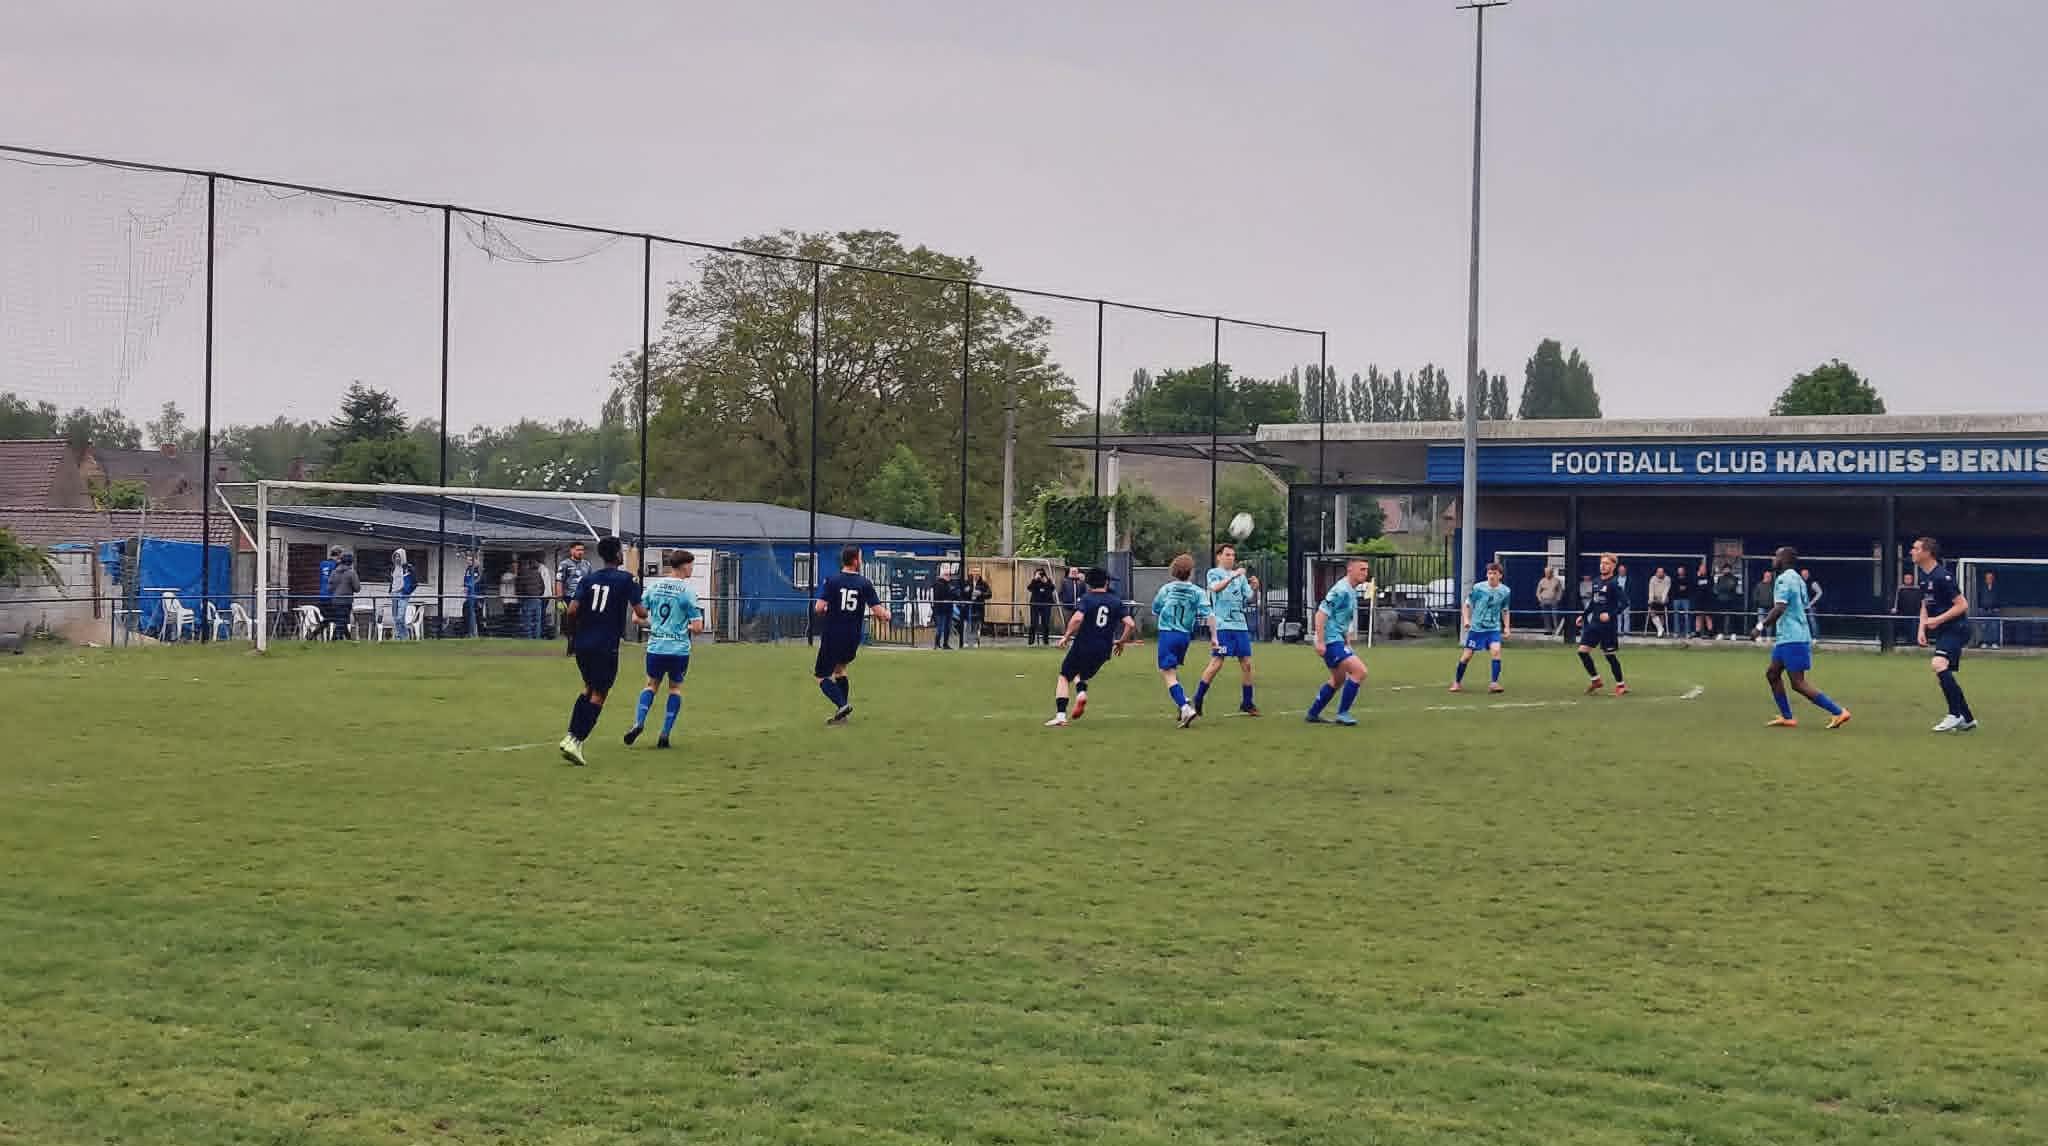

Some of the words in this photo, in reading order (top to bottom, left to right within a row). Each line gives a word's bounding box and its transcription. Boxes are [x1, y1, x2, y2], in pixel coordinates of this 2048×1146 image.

[1551, 451, 1684, 474] FOOTBALL
[1696, 451, 1767, 474] CLUB
[592, 583, 610, 613] 11
[839, 588, 858, 611] 15
[659, 603, 671, 626] 9
[1096, 605, 1109, 627] 6
